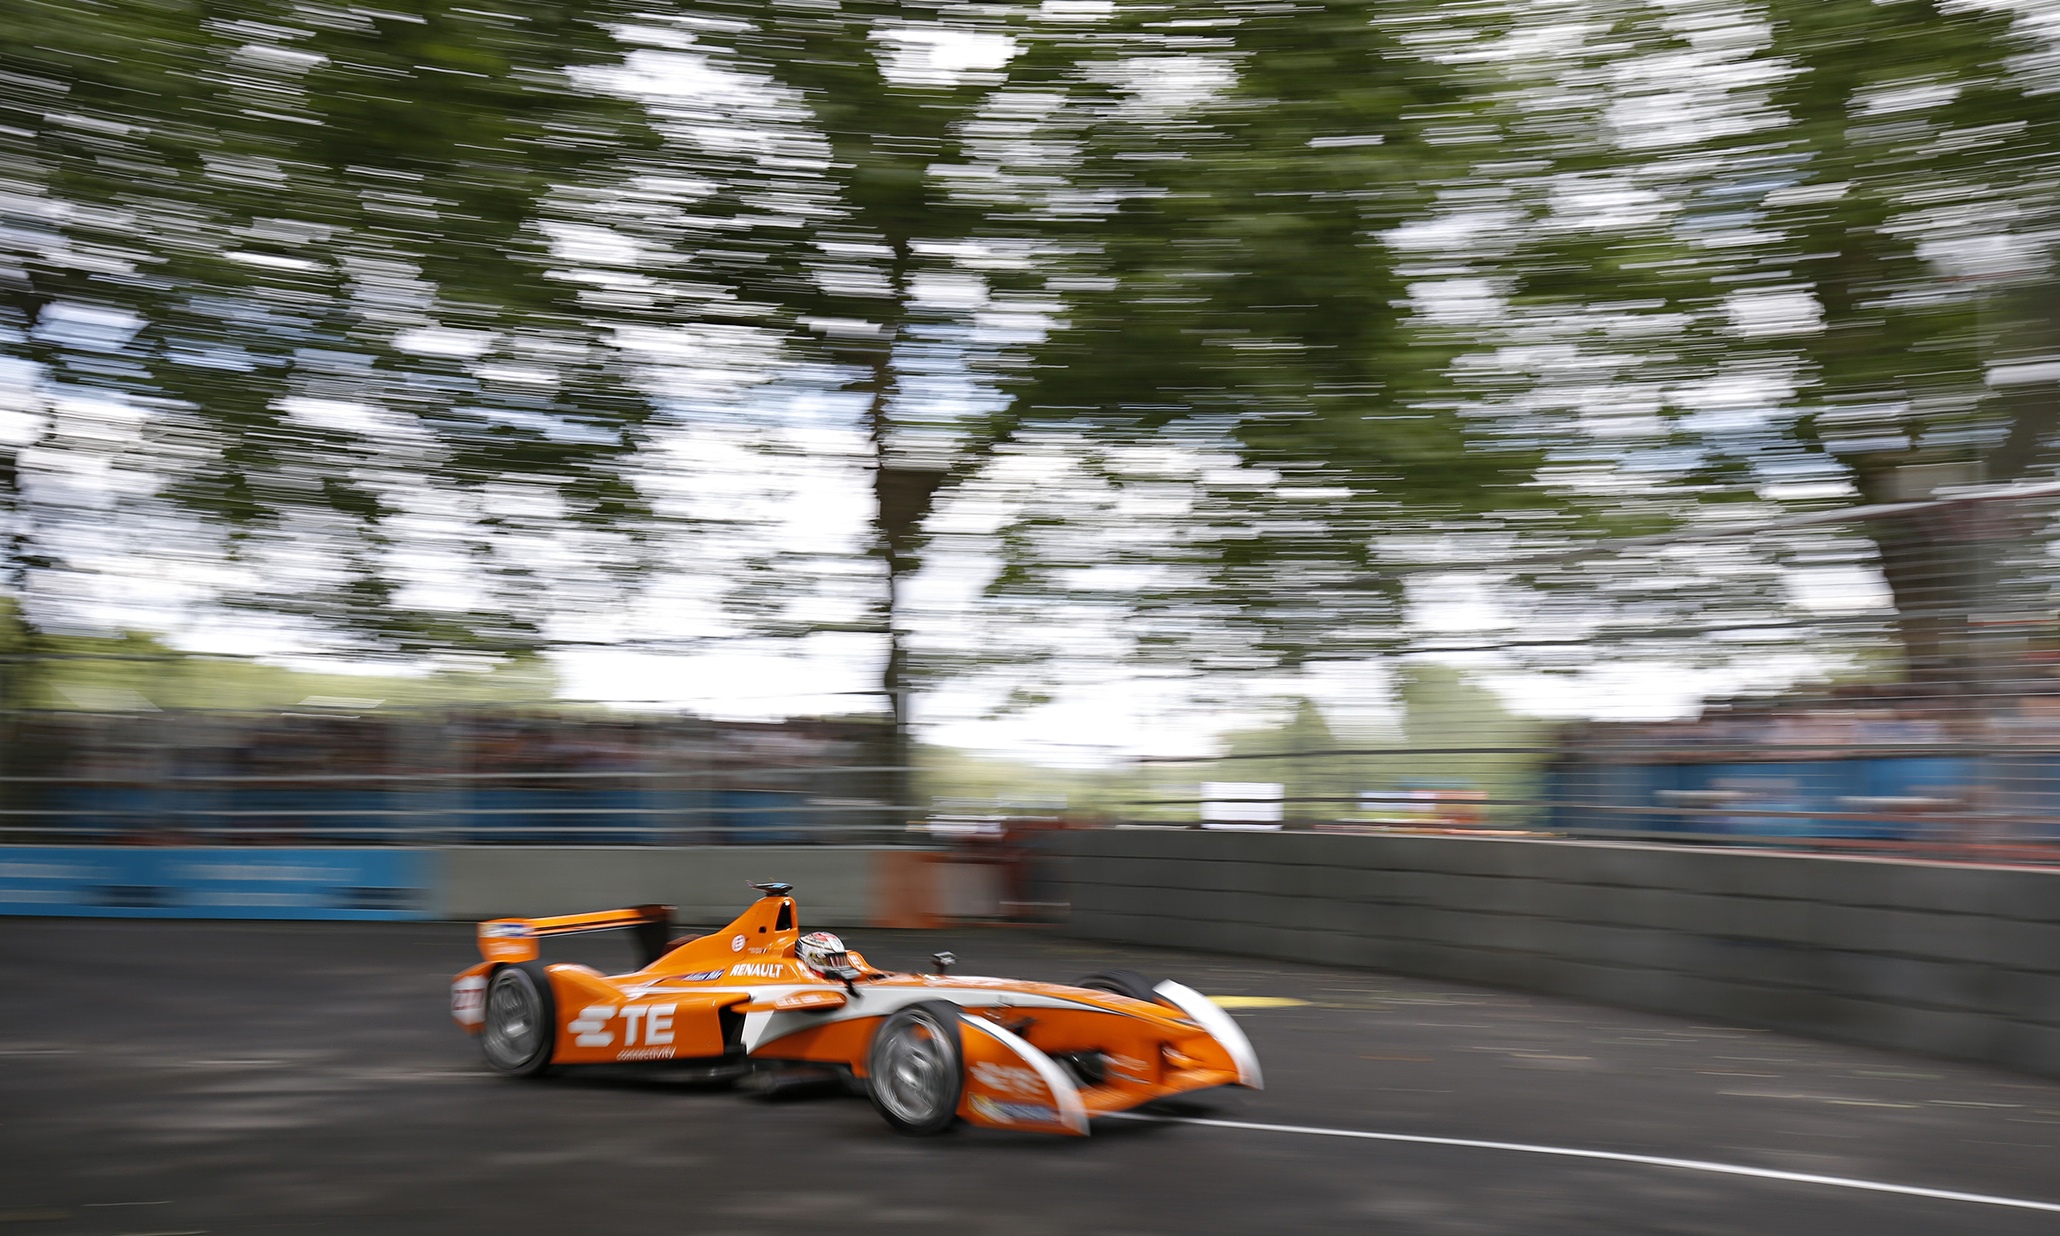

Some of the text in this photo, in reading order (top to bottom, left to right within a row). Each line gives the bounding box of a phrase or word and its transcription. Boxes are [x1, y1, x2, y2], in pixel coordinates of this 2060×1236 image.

[730, 963, 784, 979] RENAULT
[618, 1003, 678, 1047] TE
[616, 1045, 677, 1060] connectivity
